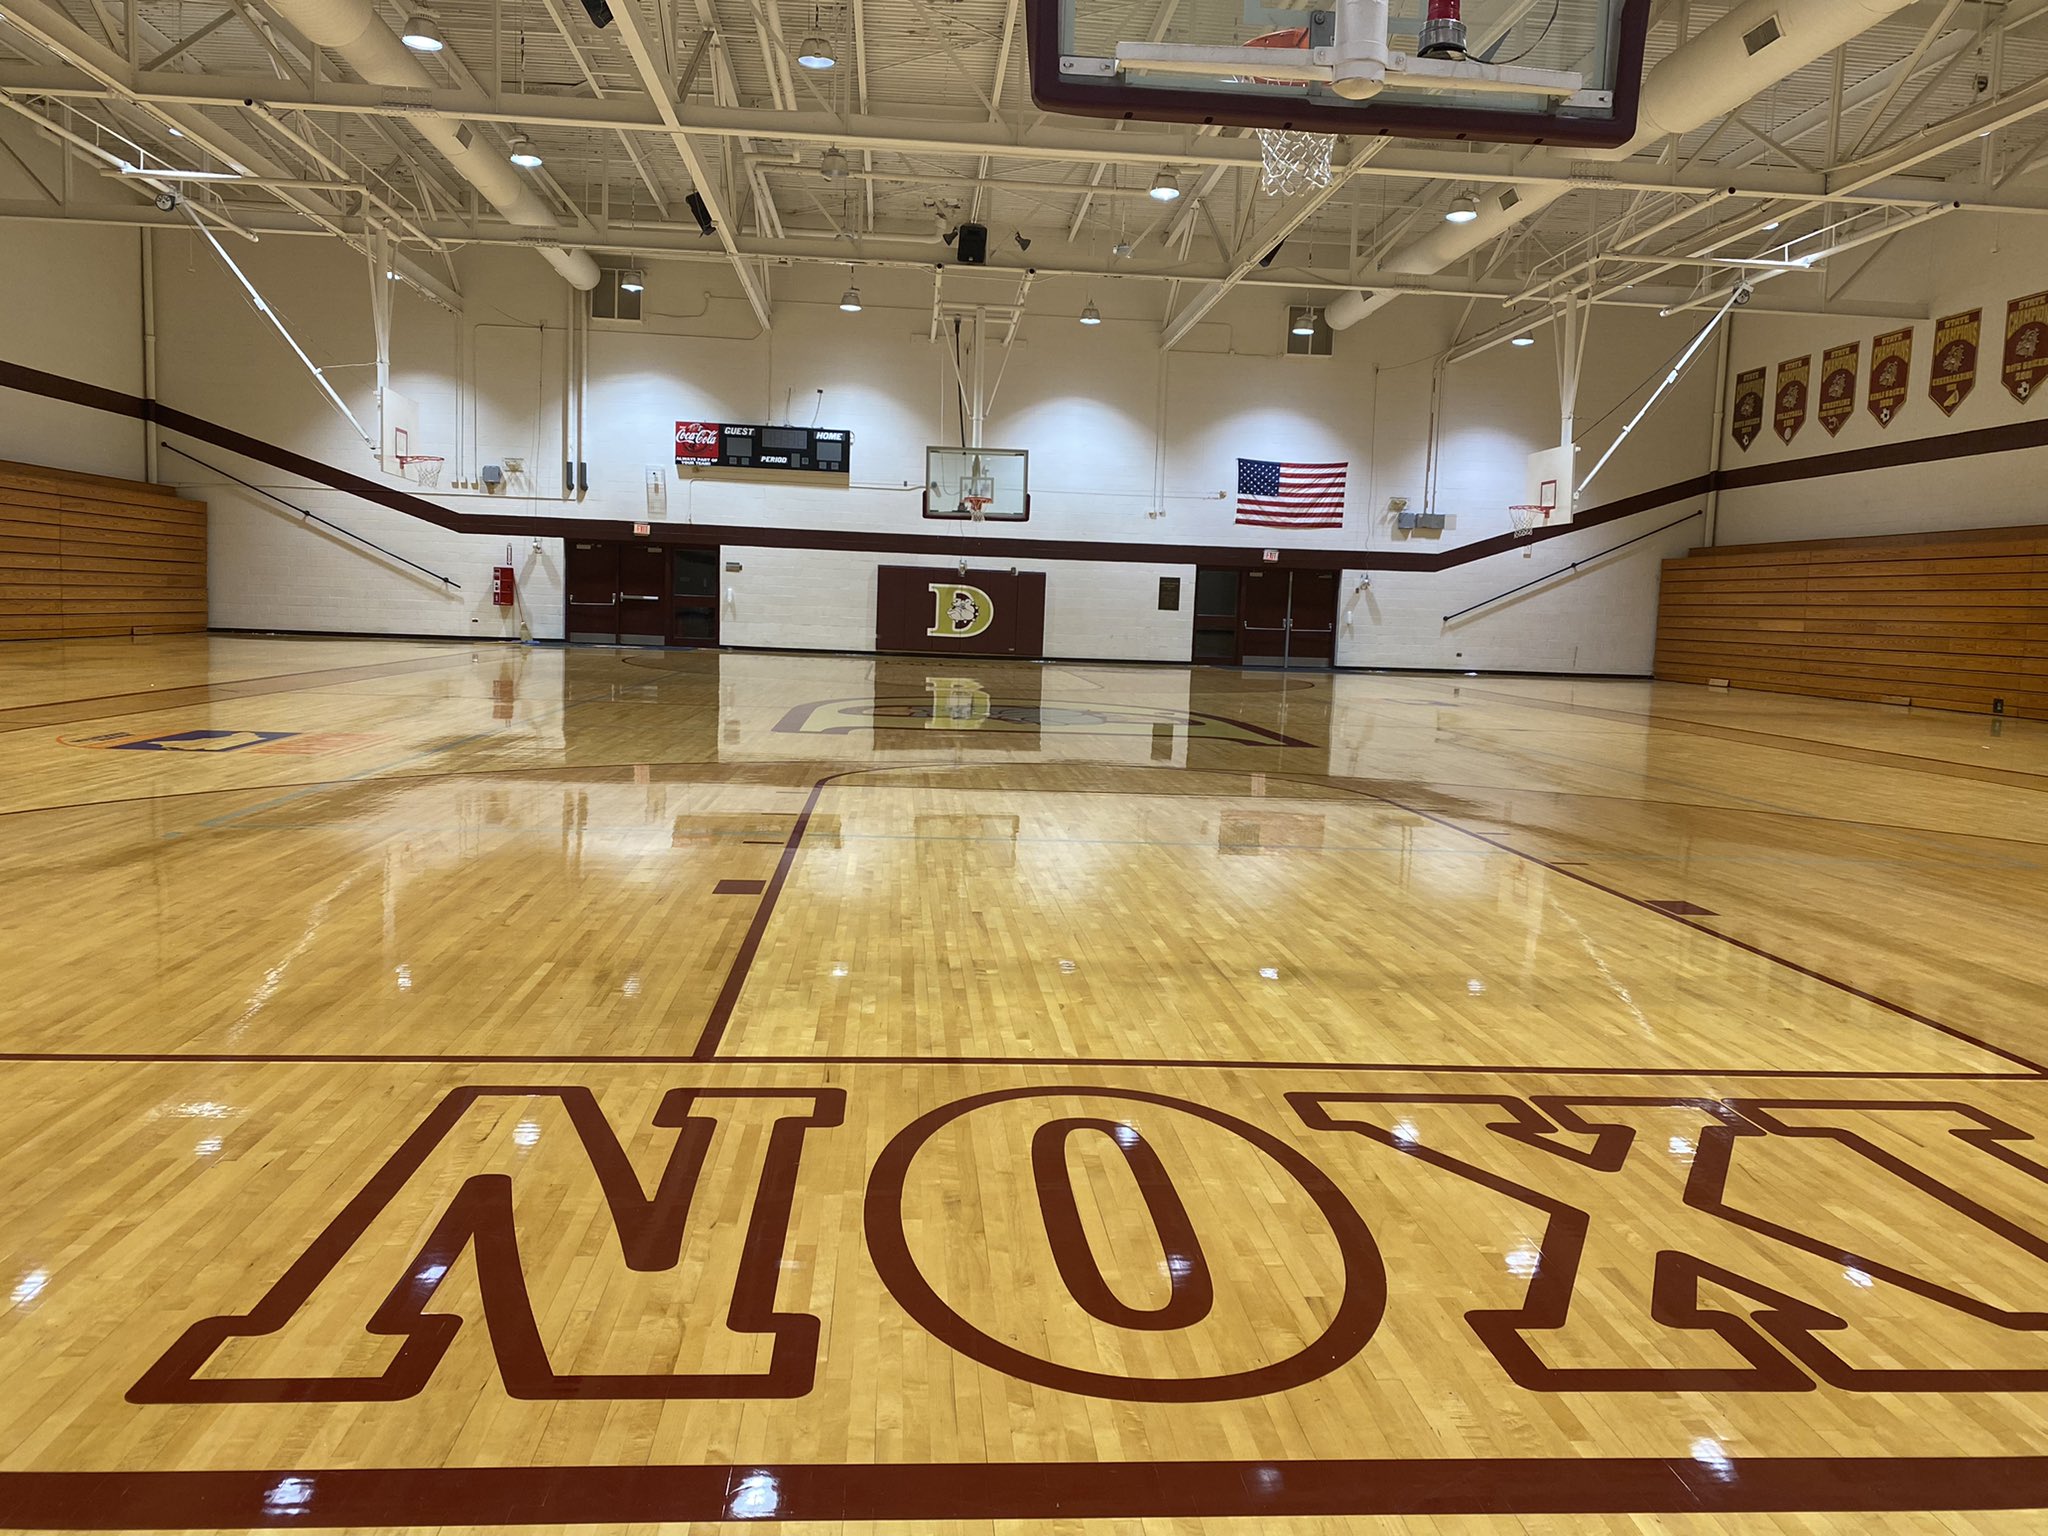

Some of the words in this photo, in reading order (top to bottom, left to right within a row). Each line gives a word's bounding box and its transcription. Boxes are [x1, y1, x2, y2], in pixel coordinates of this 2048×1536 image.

[2018, 295, 2046, 312] STATE
[1944, 314, 1970, 328] STATE
[1881, 333, 1903, 345] STATE
[724, 426, 755, 436] GUEST
[816, 431, 843, 441] HOME
[760, 455, 788, 464] PERIOD
[927, 582, 994, 638] D
